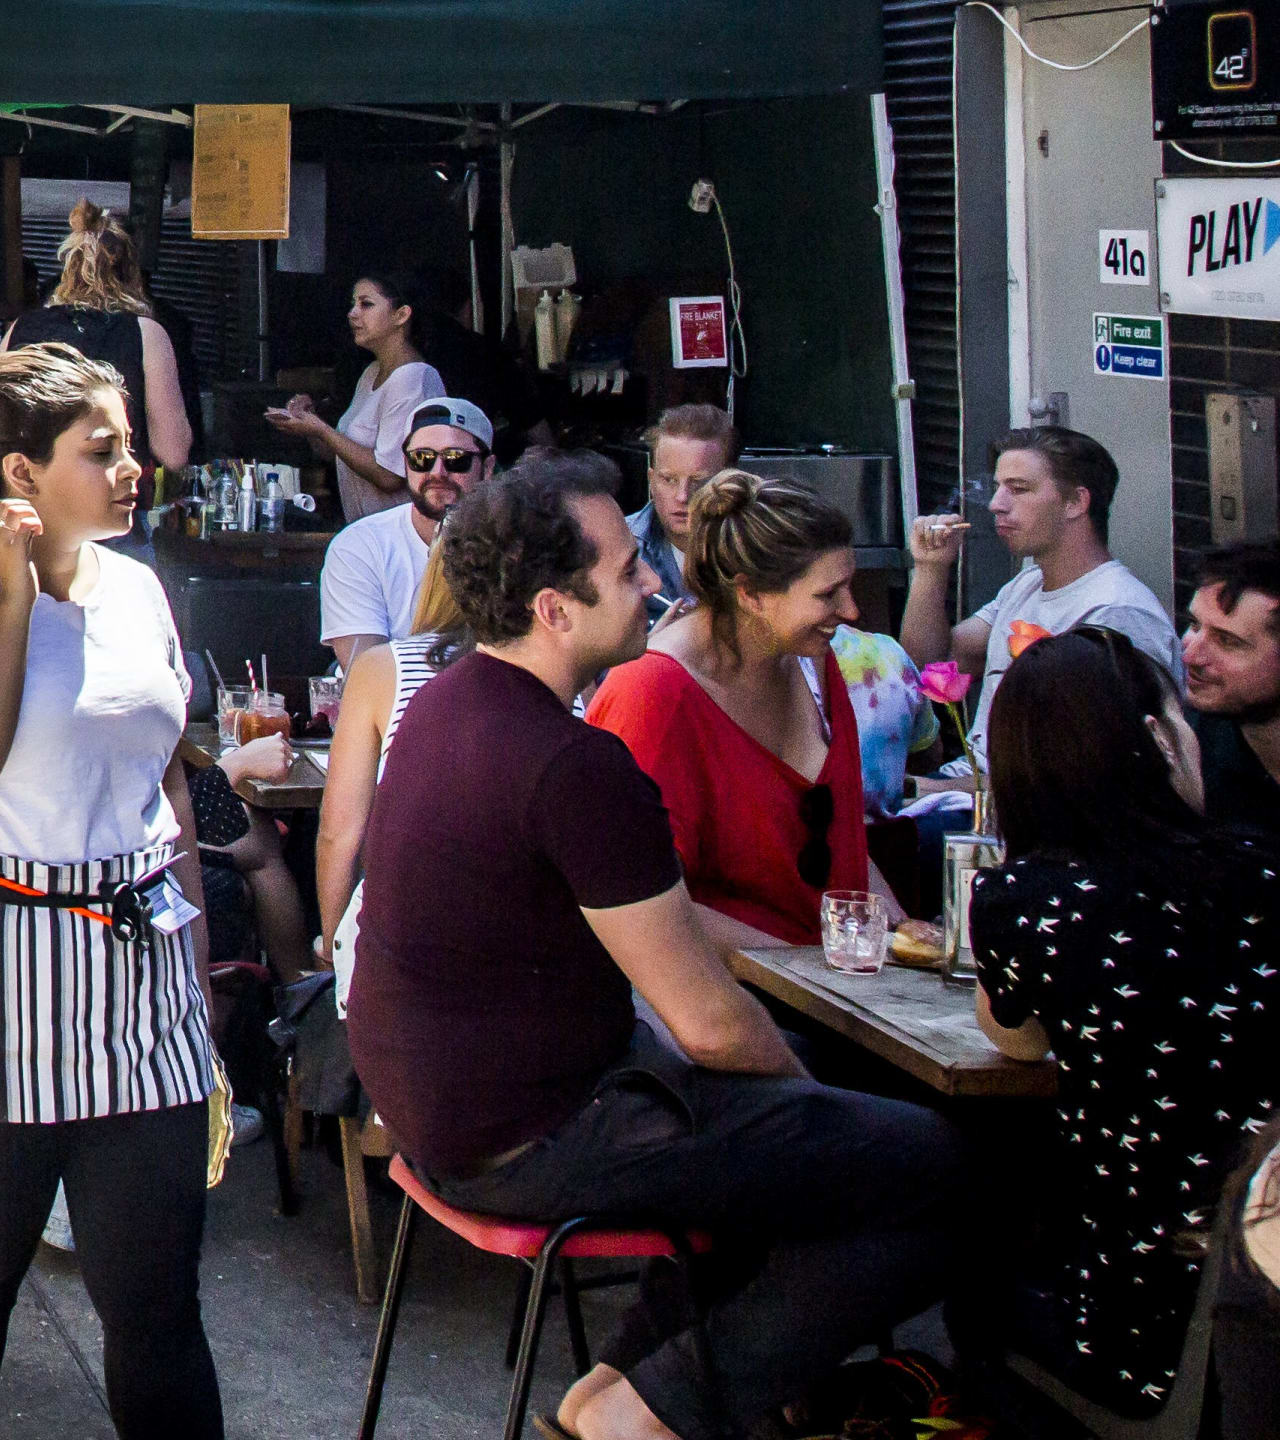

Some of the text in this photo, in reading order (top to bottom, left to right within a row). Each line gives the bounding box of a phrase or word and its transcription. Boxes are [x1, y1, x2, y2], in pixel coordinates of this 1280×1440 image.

[1187, 197, 1262, 277] PLAY
[1104, 238, 1145, 276] 41a
[694, 311, 722, 321] BLANKET
[1113, 323, 1152, 340] Fire exit
[1114, 352, 1157, 368] Keep clear
